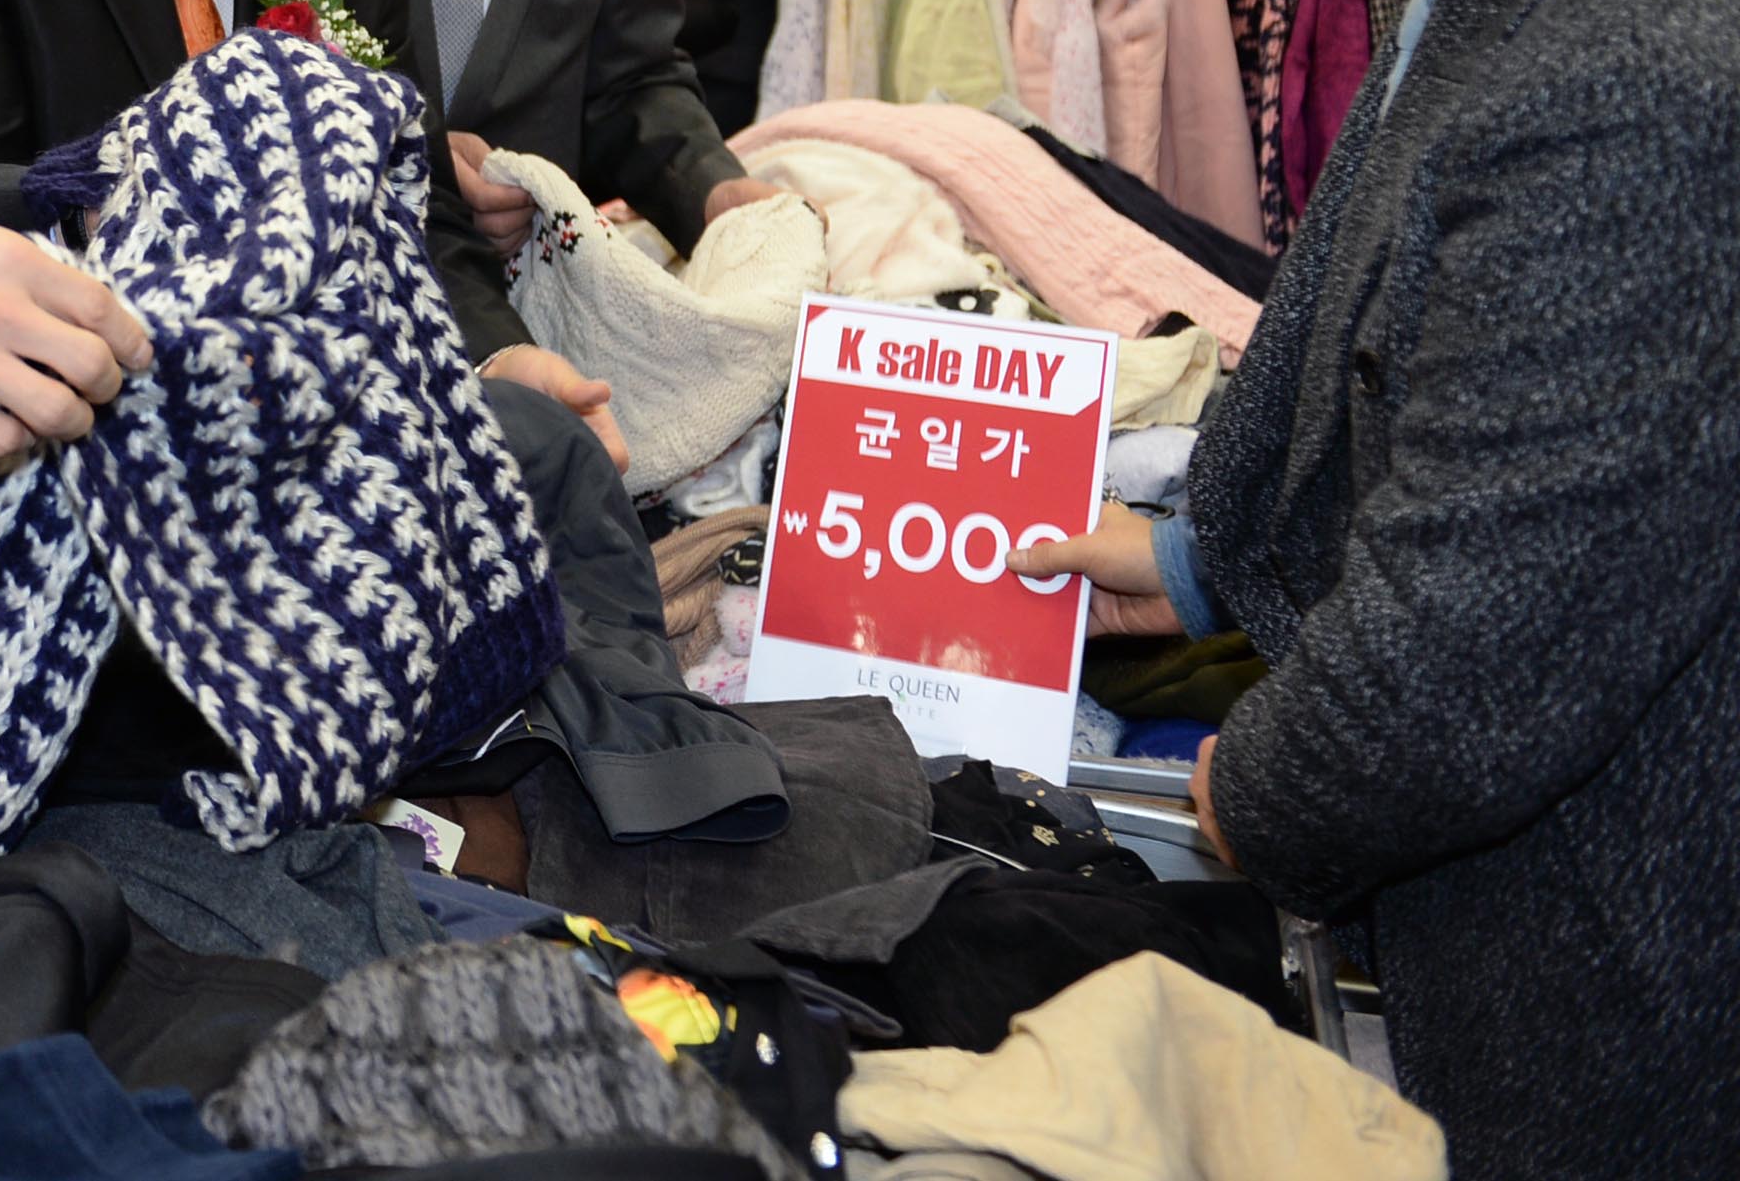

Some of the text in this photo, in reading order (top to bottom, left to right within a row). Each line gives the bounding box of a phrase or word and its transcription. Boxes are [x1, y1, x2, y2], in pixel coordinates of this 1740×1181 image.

[837, 326, 1065, 400] K sale DAY
[857, 668, 960, 703] LE QUEEN
